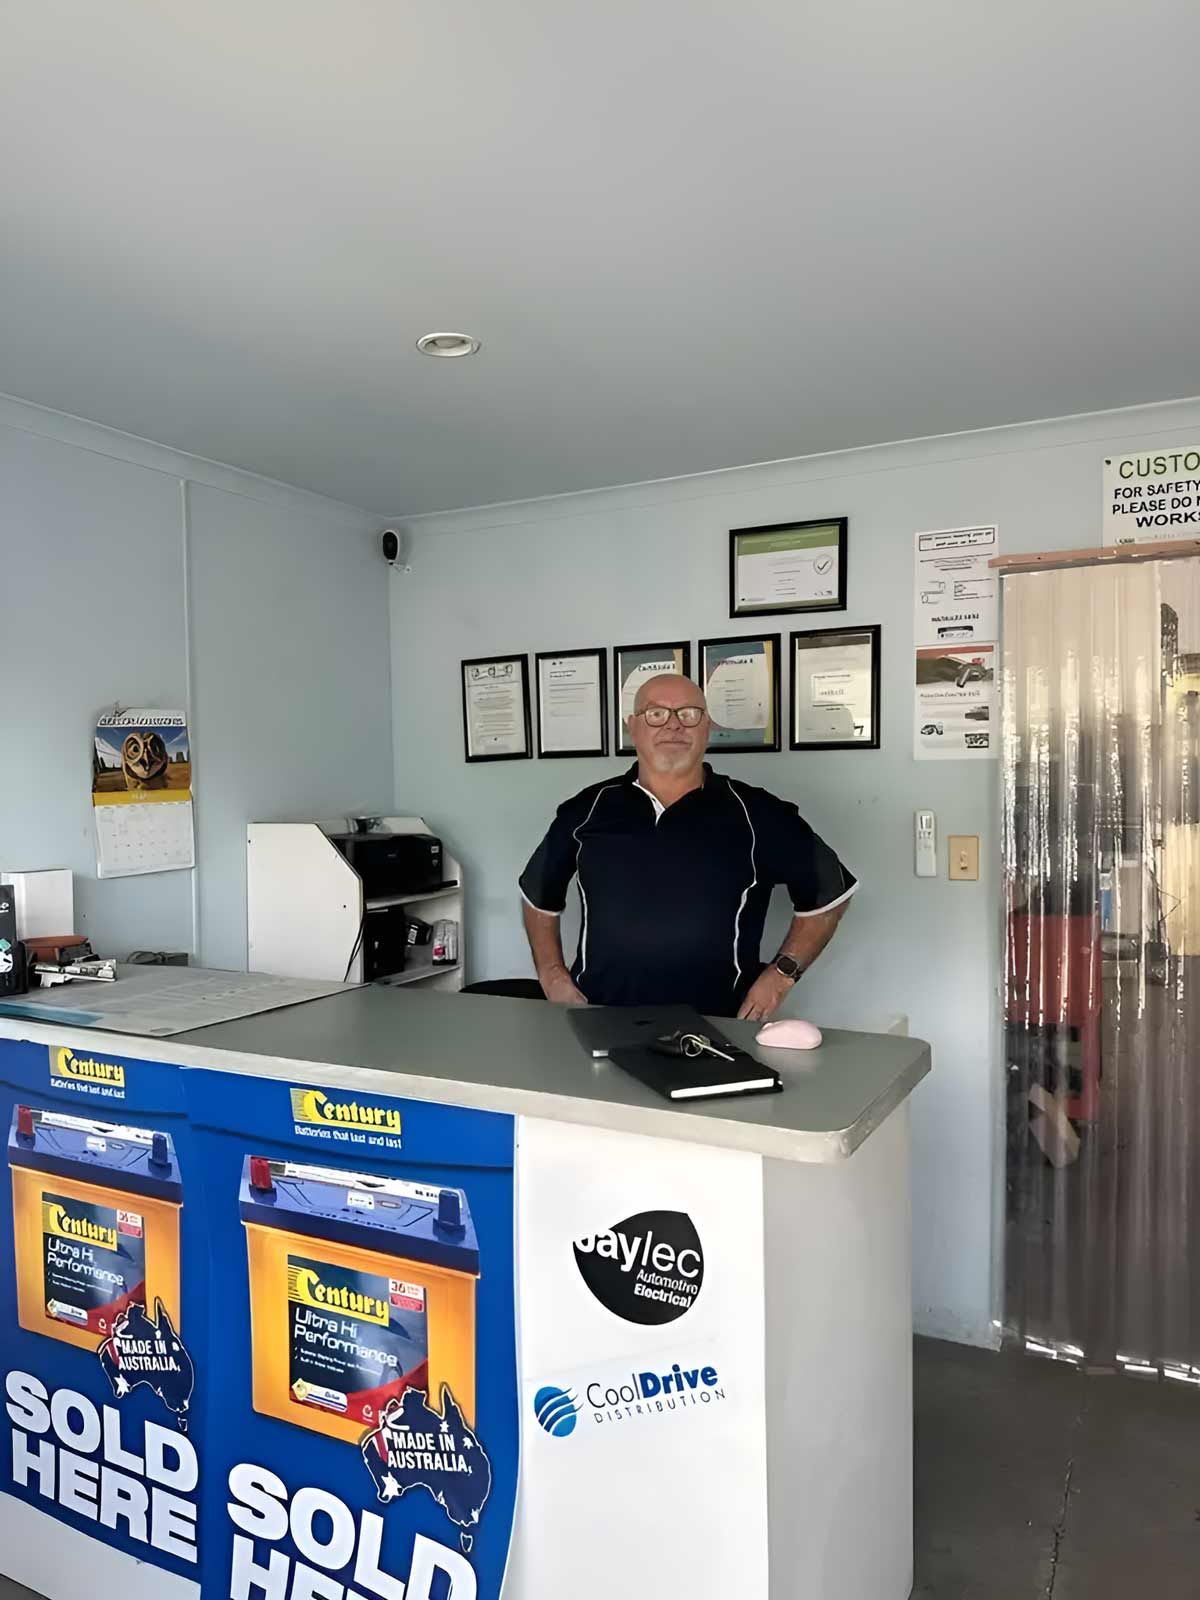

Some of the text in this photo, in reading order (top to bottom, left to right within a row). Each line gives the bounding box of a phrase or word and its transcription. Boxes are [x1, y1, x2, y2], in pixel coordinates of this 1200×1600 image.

[1112, 499, 1166, 515] PLEASE
[1171, 496, 1192, 509] DO
[1114, 486, 1142, 499] FOR
[1136, 511, 1200, 528] WORK
[57, 1047, 125, 1088] Century
[303, 1090, 402, 1135] Century
[49, 1204, 118, 1251] Century
[296, 1268, 389, 1327] Century
[634, 1283, 692, 1308] Electrical
[295, 1307, 358, 1338] Ultra Hi
[121, 1339, 167, 1355] MADE IN
[294, 1324, 397, 1367] Performance
[594, 1388, 726, 1423] DISTRIBUTION
[6, 1370, 199, 1493] SOLD
[392, 1431, 456, 1452] MADE IN
[12, 1428, 198, 1564] HERE
[227, 1463, 477, 1600] SOLD
